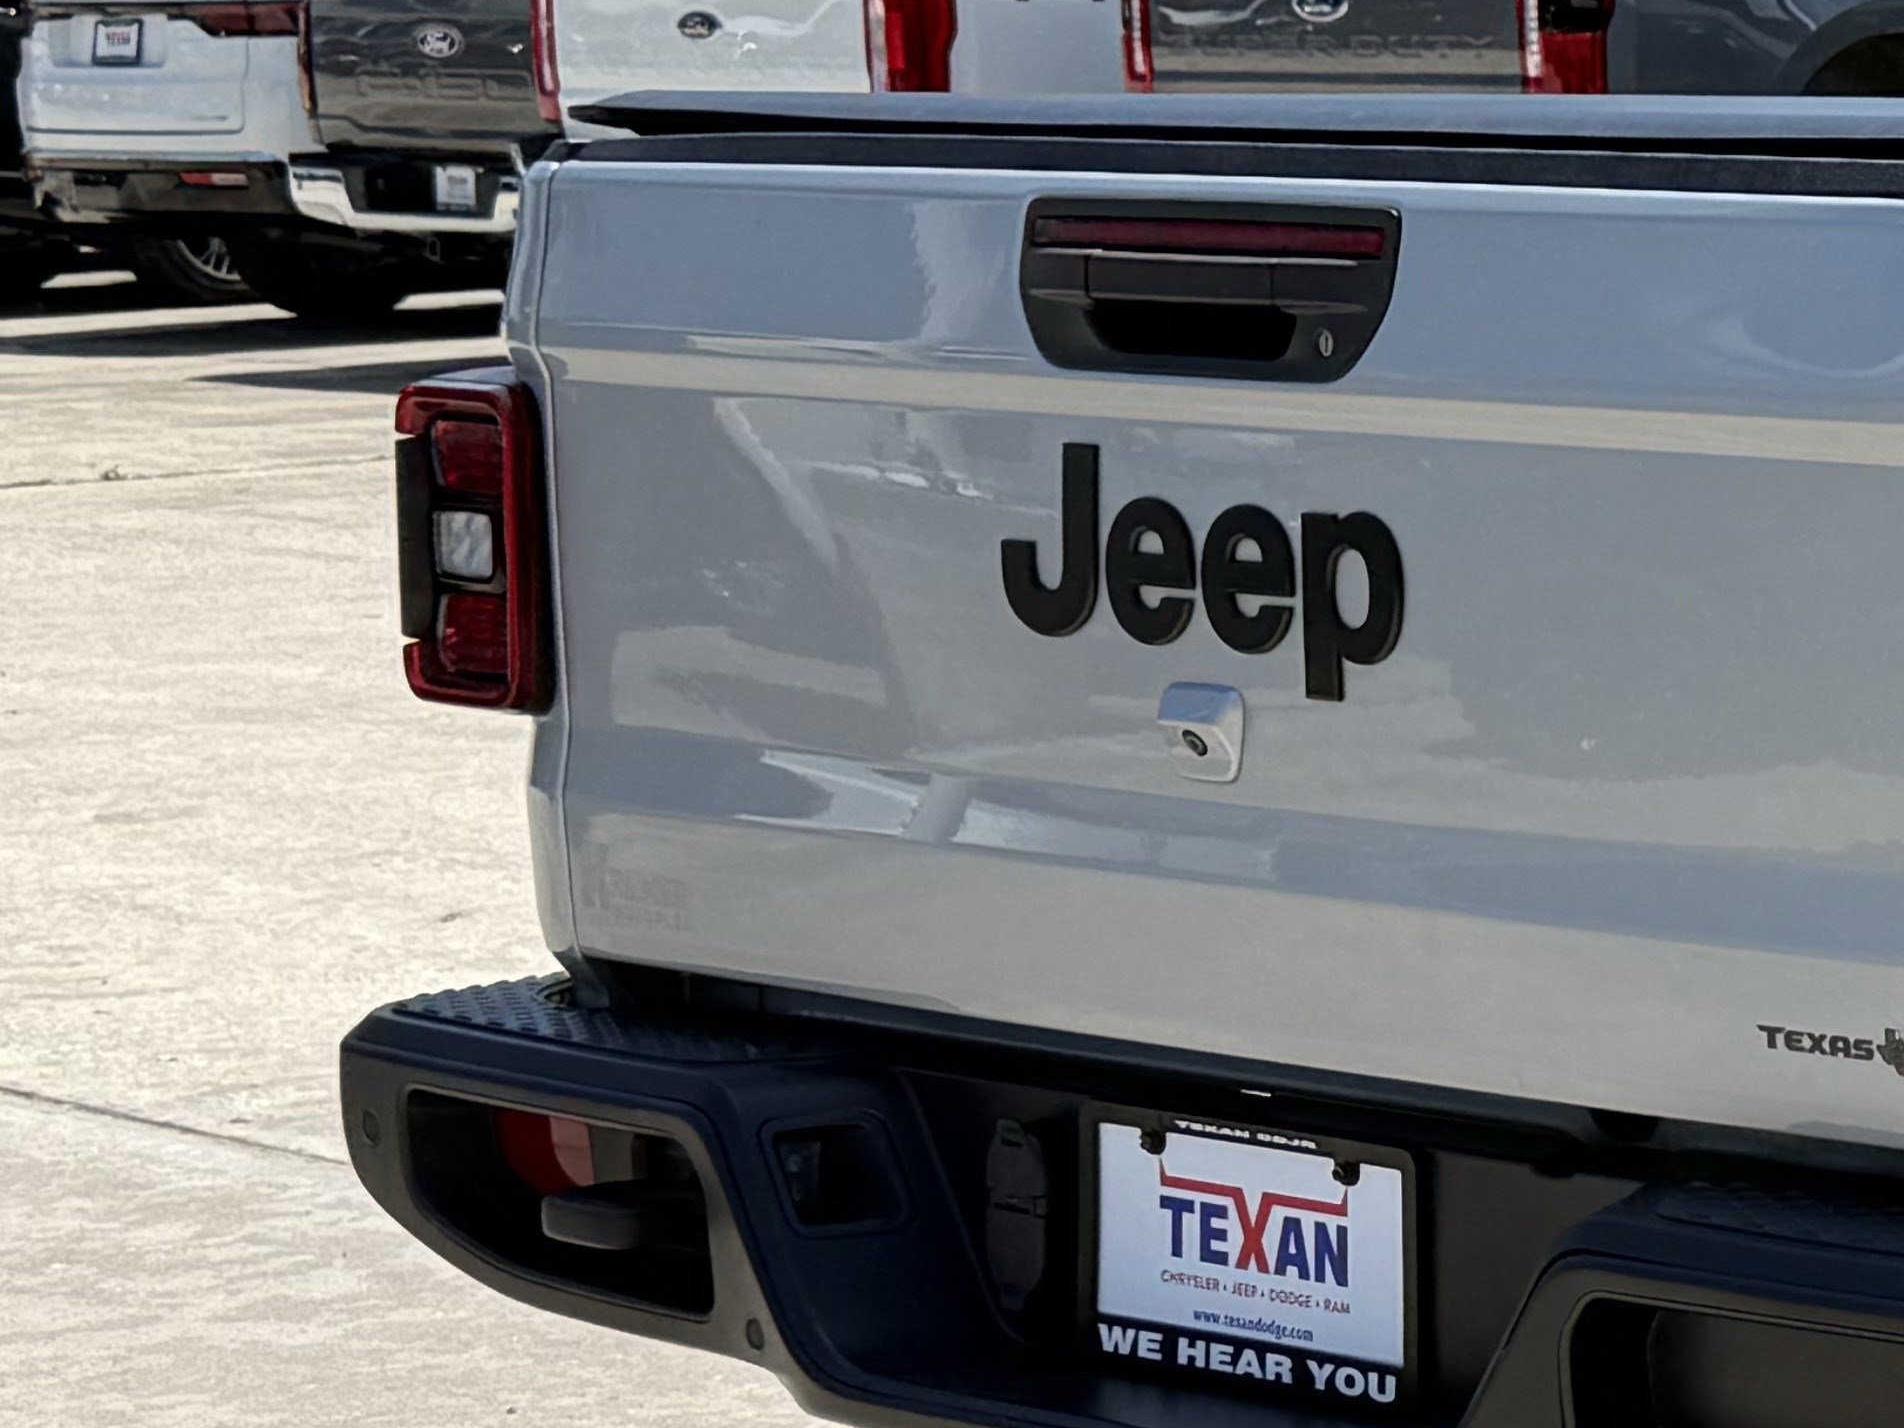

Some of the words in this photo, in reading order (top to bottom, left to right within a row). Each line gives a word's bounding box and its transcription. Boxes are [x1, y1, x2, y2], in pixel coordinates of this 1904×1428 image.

[1001, 442, 1404, 702] Jeep
[1756, 1024, 1875, 1061] TEXAS
[1159, 1170, 1349, 1288] TEXAN
[1231, 1282, 1258, 1298] JEEP
[1268, 1289, 1313, 1309] DODGE
[1323, 1298, 1351, 1314] RAM
[1097, 1323, 1164, 1361] WE
[1176, 1338, 1293, 1384] HEAR
[1306, 1359, 1396, 1403] YOU
